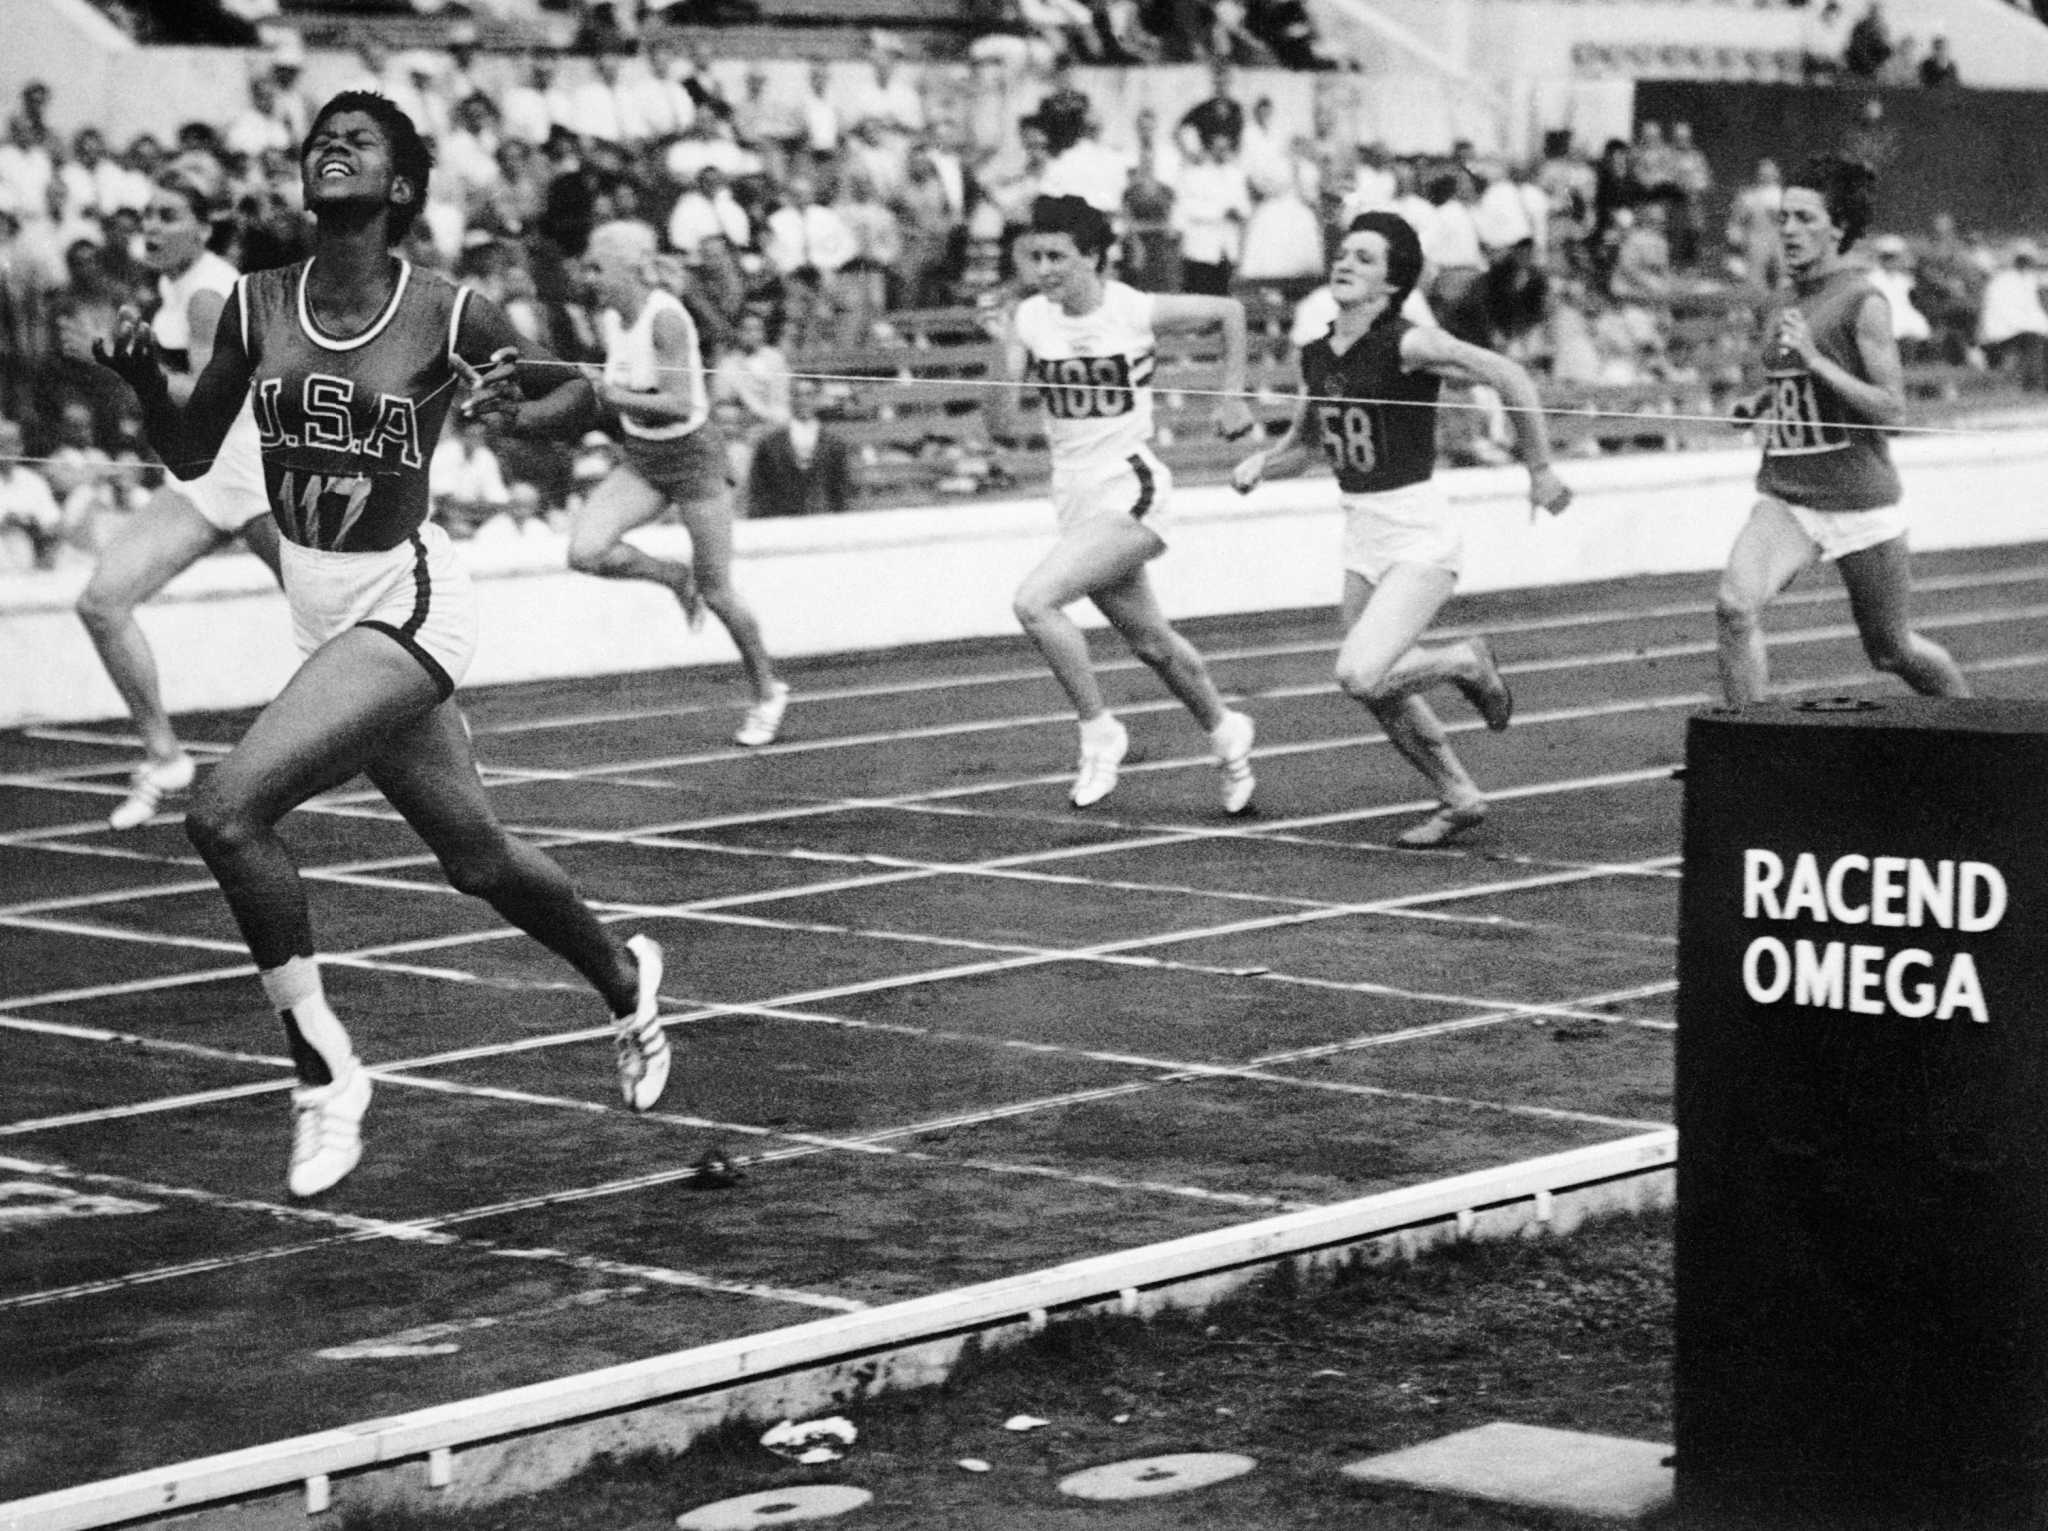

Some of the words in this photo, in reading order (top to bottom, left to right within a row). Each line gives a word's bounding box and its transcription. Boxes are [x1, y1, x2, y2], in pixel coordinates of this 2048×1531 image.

[1318, 406, 1376, 473] 58
[278, 471, 373, 551] 117
[1743, 848, 2008, 932] RACEND
[1742, 936, 1990, 1023] OMEGA
